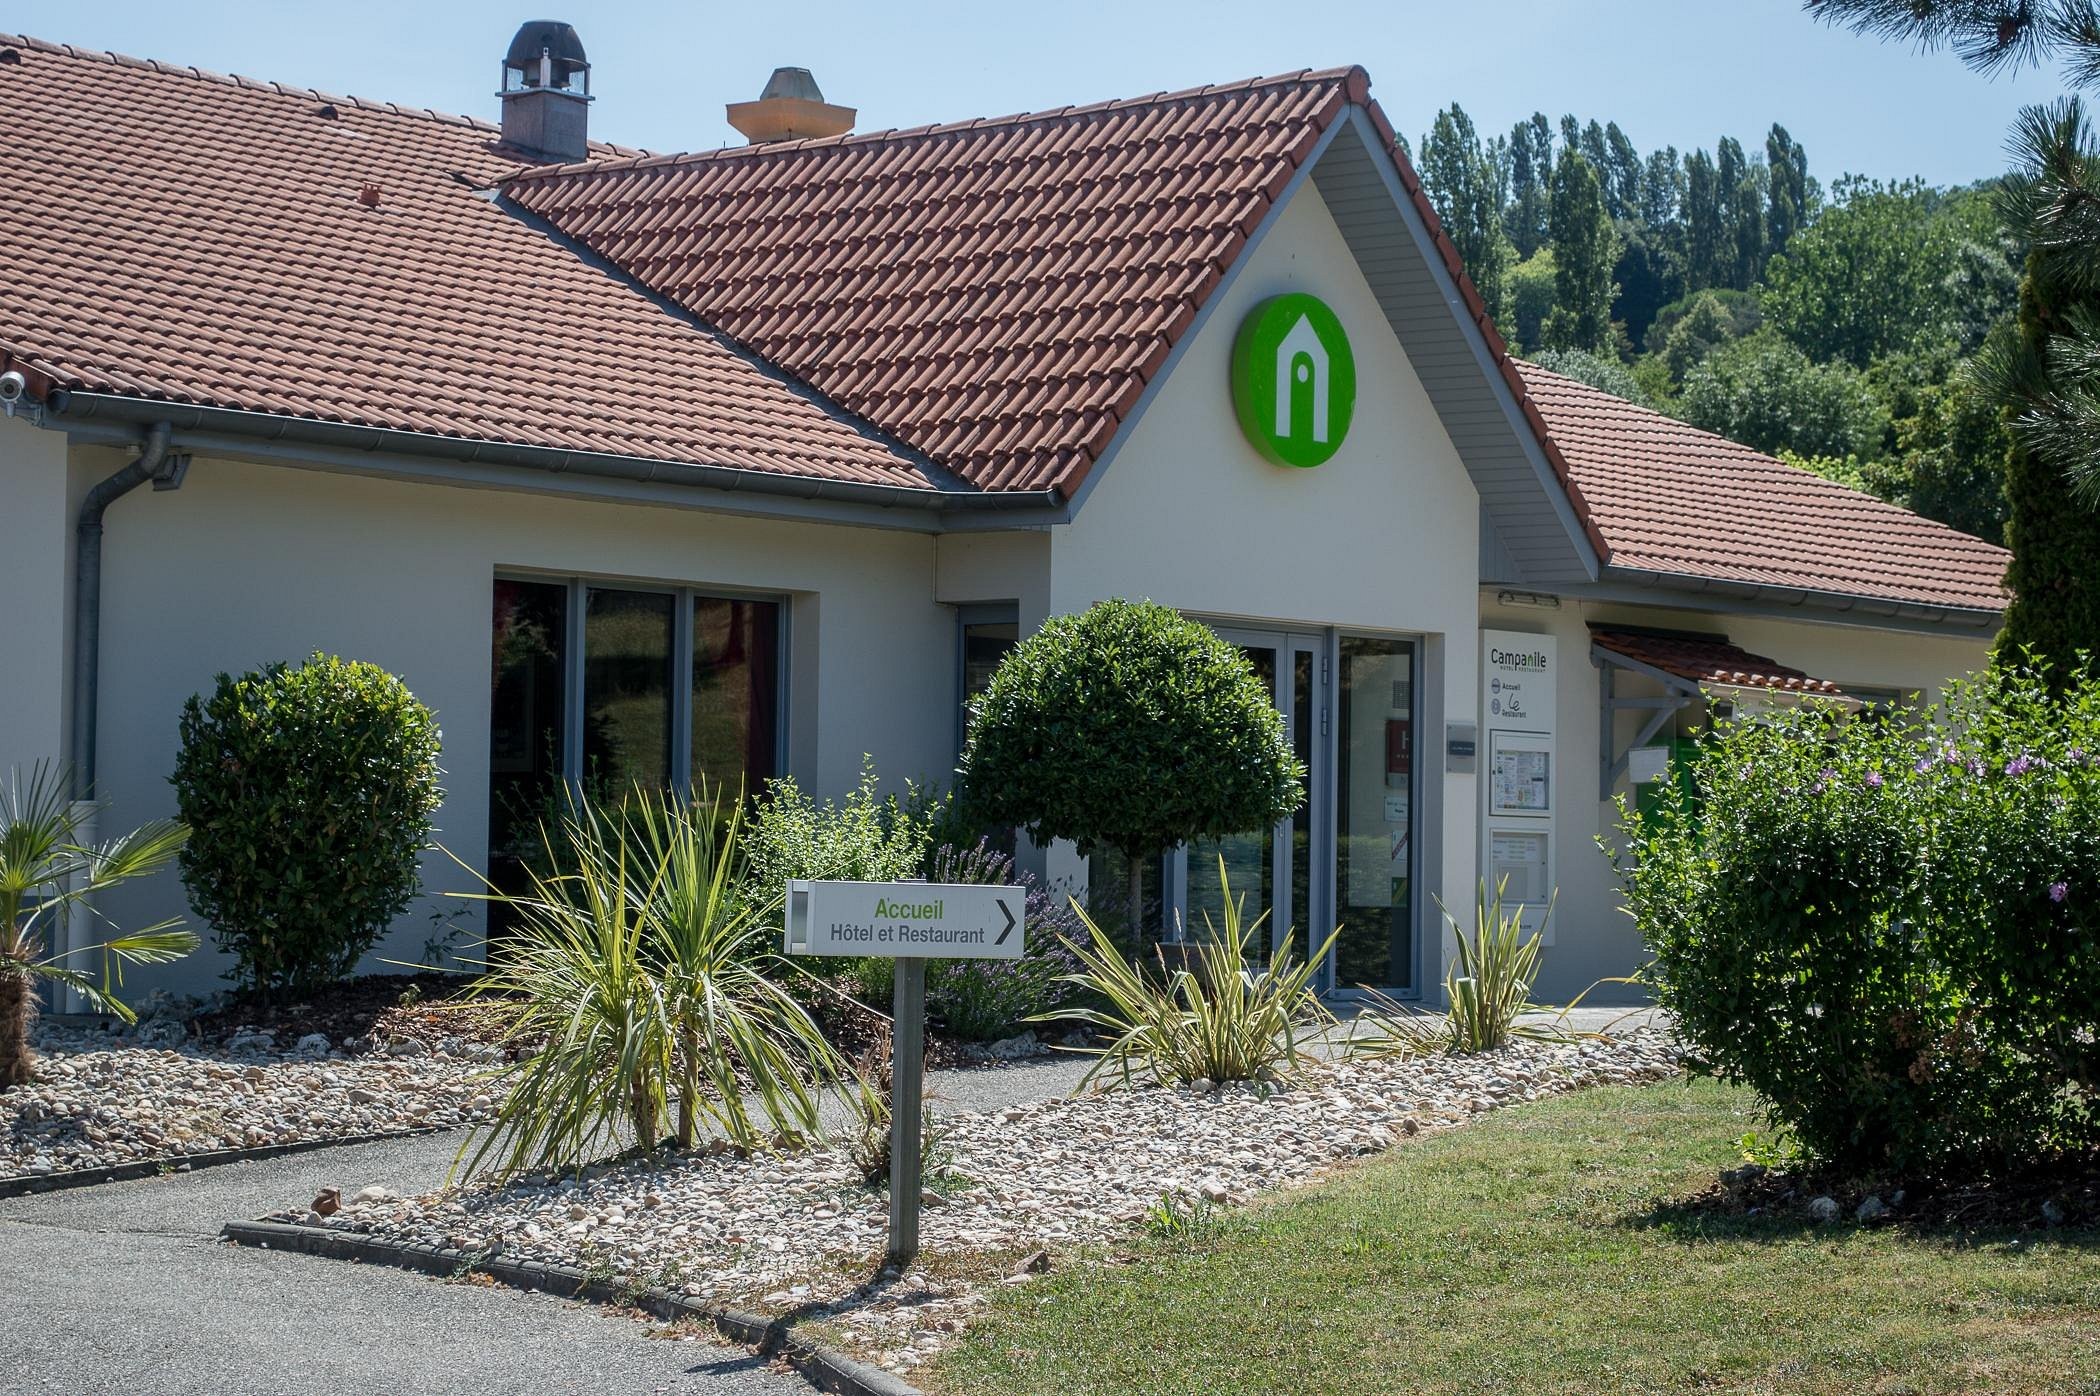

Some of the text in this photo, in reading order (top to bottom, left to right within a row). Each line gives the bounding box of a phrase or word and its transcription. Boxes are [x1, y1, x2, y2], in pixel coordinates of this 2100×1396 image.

[1491, 648, 1547, 671] Campanile
[1502, 709, 1527, 718] Restaurant
[875, 898, 943, 919] Accueil
[831, 924, 985, 943] Hôtel et Restaurant
